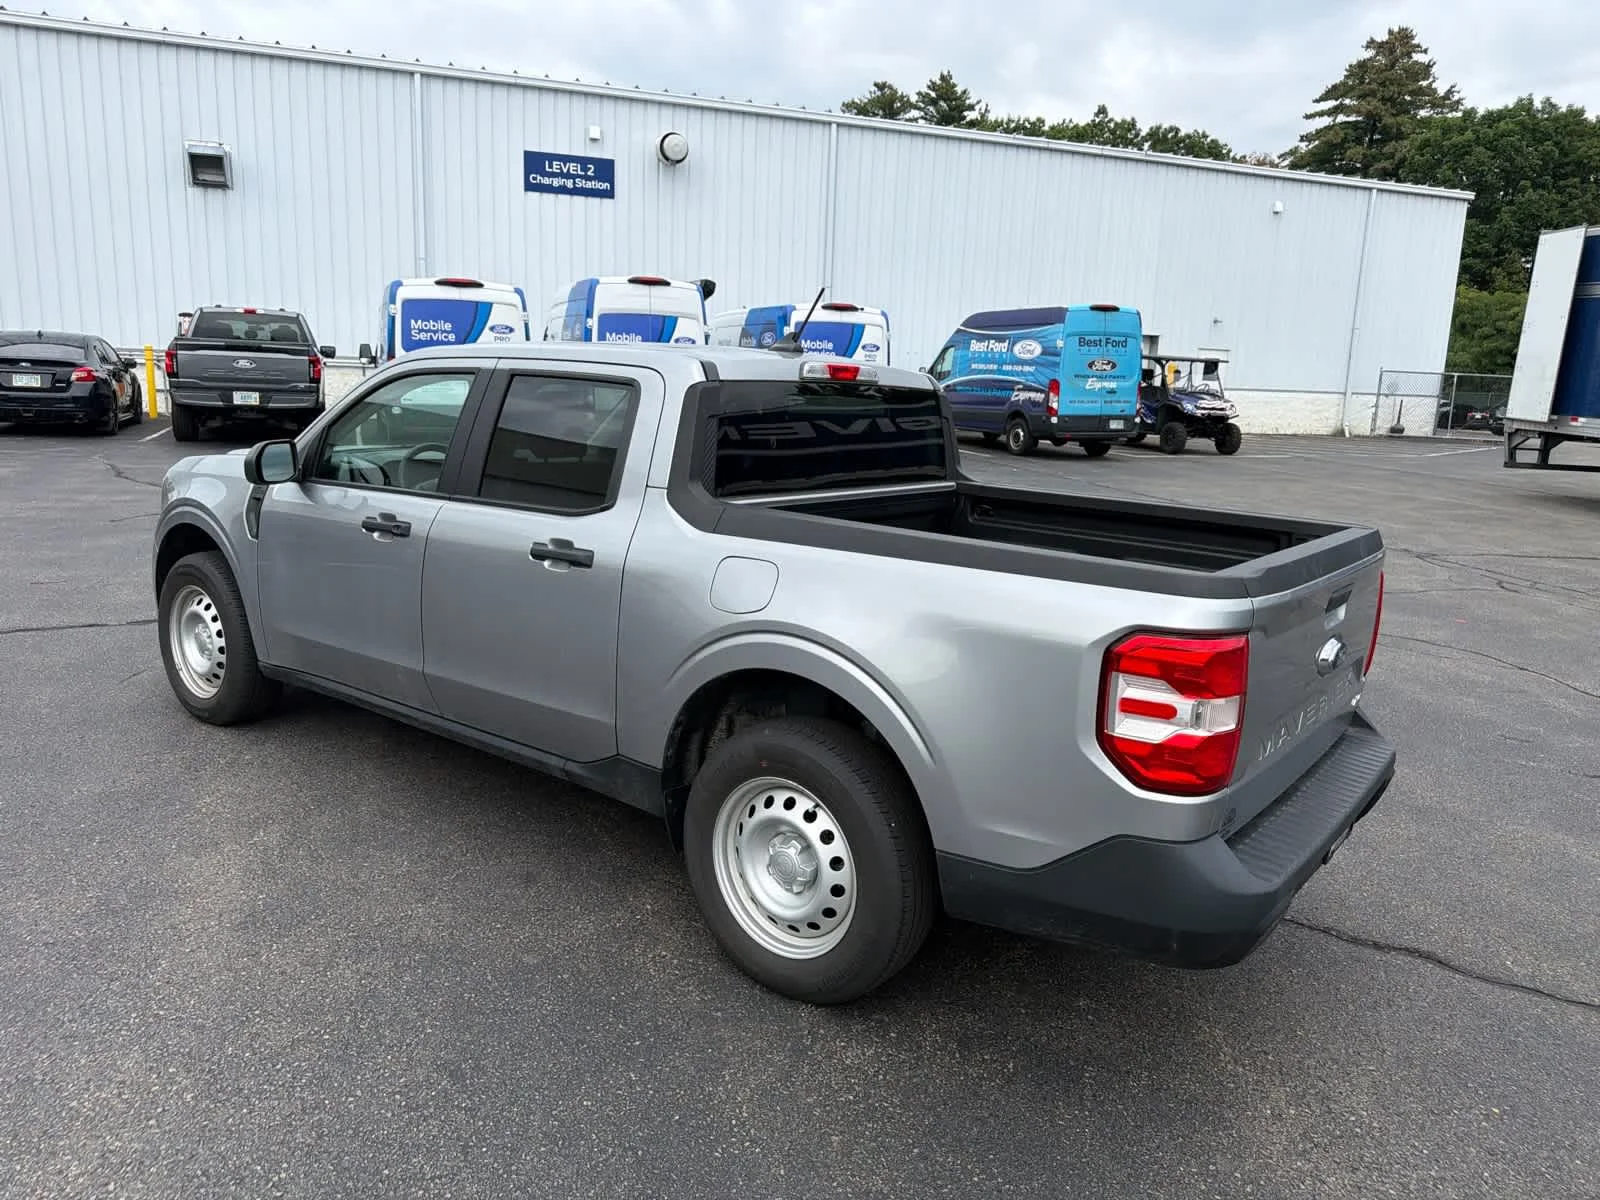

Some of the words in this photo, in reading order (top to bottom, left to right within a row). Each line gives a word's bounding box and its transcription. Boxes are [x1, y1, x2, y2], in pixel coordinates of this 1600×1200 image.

[545, 160, 585, 175] LEVEL
[587, 164, 595, 176] 2
[529, 174, 574, 189] Charging
[575, 178, 611, 190] Station
[410, 319, 452, 331] Mobile
[411, 330, 456, 342] Service
[605, 332, 642, 343] Mobile
[801, 340, 834, 350] Mobile
[970, 340, 988, 352] Best
[988, 340, 1009, 352] Ford
[1078, 337, 1102, 348] Best
[1105, 338, 1128, 348] Ford
[1085, 378, 1118, 392] Express
